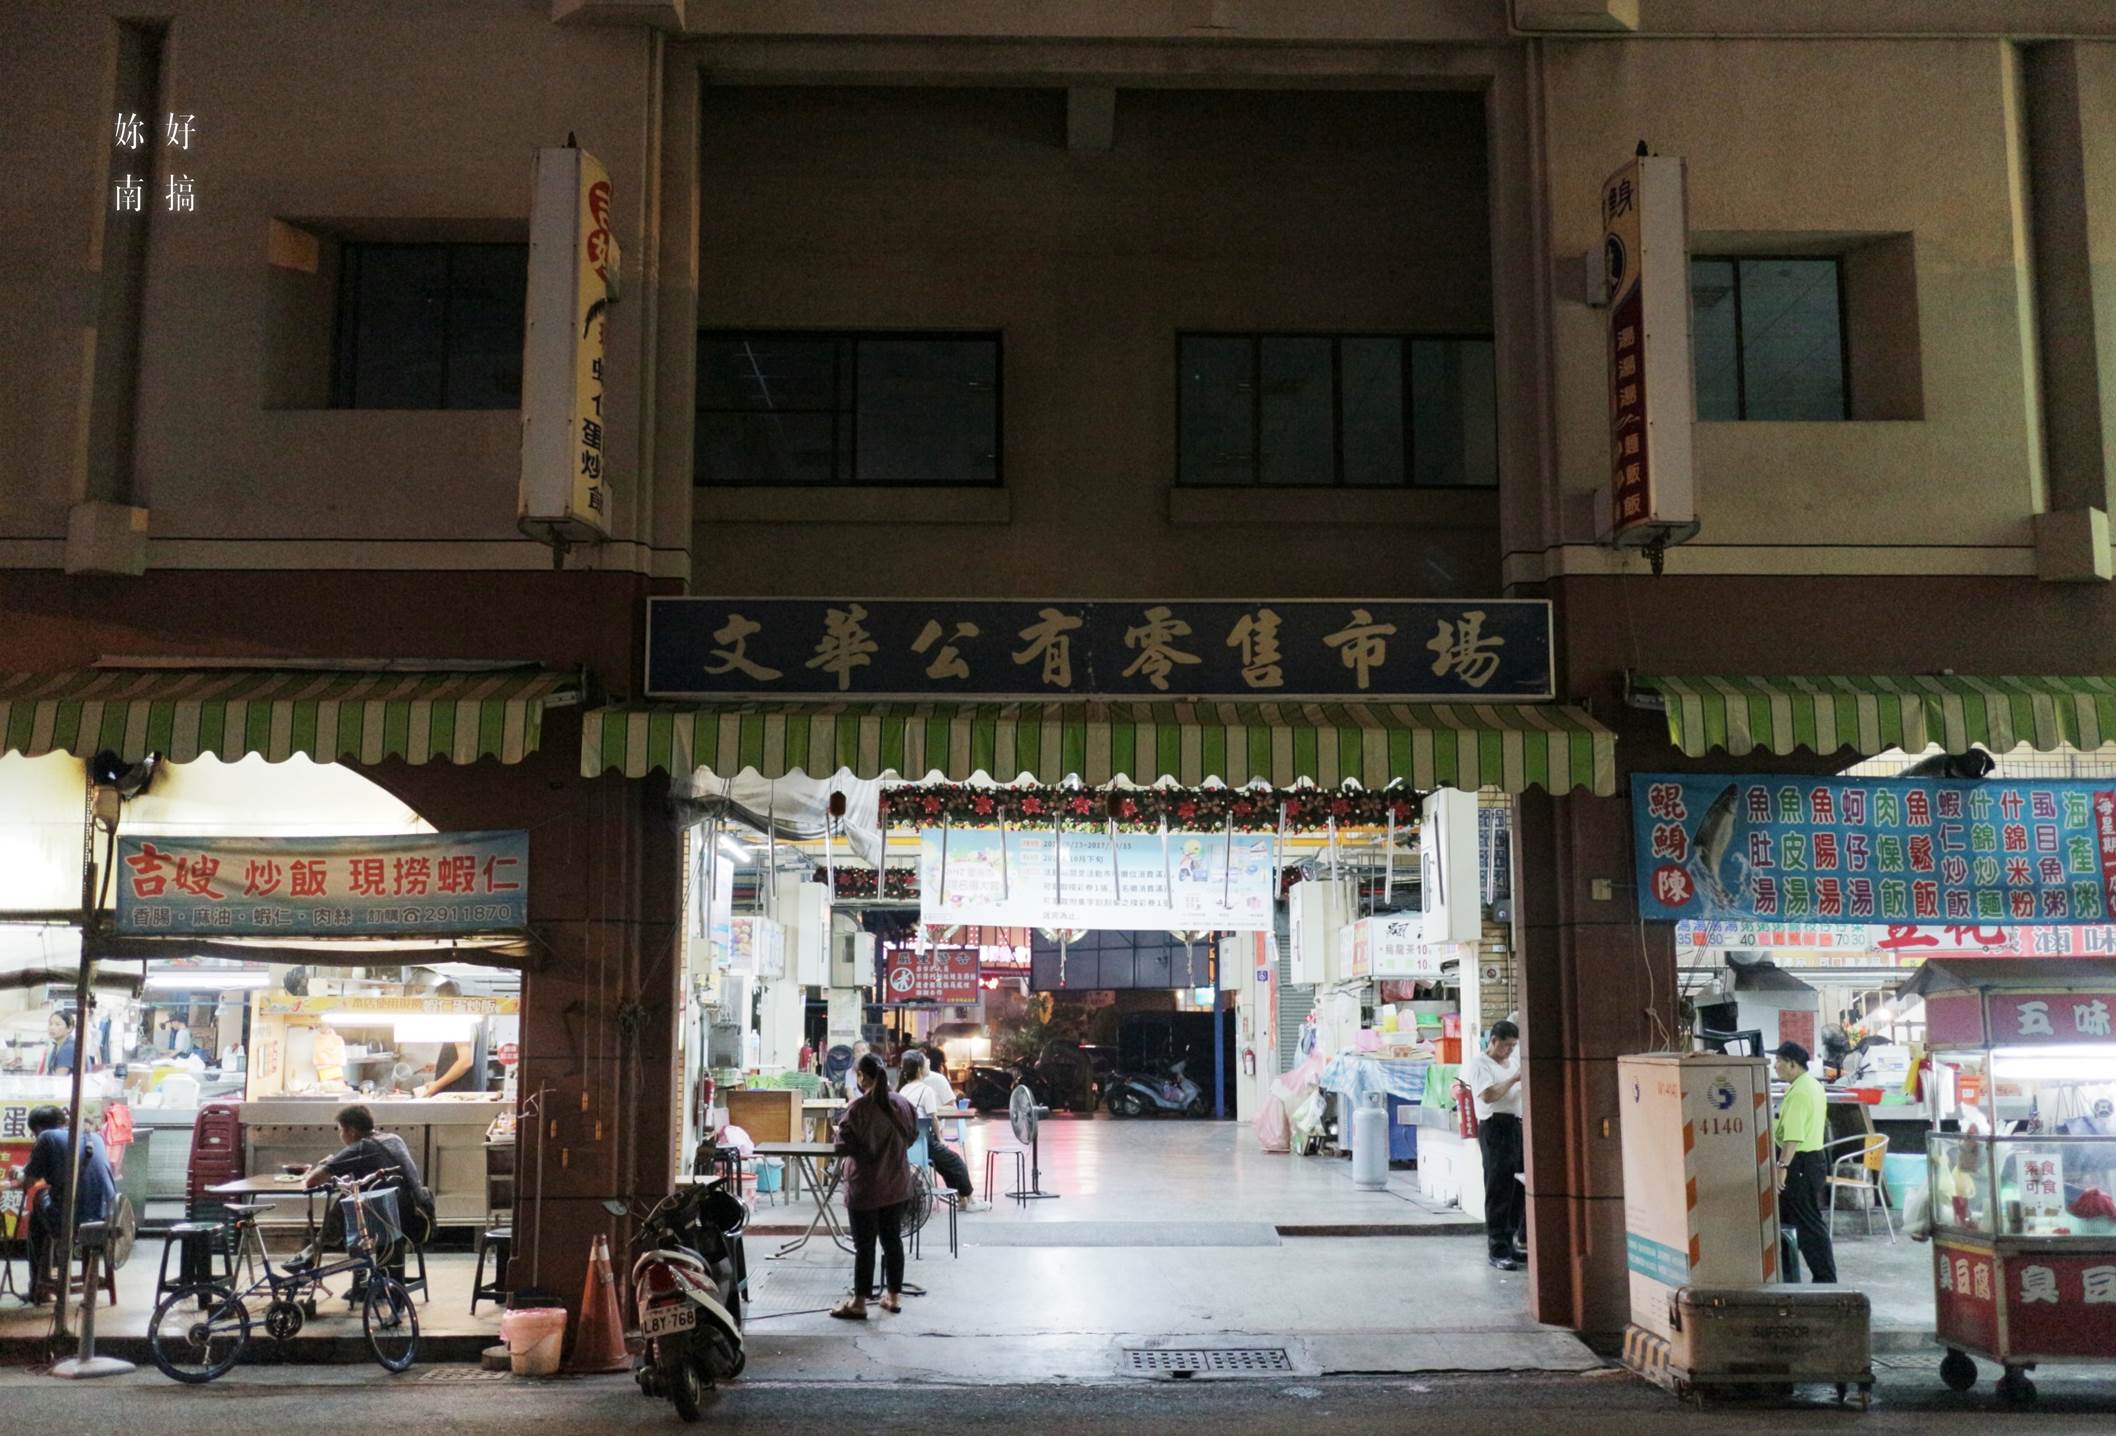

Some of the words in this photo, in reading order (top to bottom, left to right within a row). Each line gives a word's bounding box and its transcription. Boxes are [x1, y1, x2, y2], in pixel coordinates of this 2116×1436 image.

[705, 603, 1505, 690] 文華公有零售市場
[243, 858, 327, 898] 炒飯
[348, 854, 520, 897] 現撈蝦仁
[422, 905, 512, 923] 2911870
[1746, 786, 1778, 914] 魚肚湯
[1777, 786, 1810, 916] 魚皮湯
[1809, 786, 1842, 916] 魚腸湯
[1841, 788, 1874, 916] 蚵仔湯
[1874, 788, 1907, 918] 肉燥飯
[1906, 788, 1940, 919] 魚鬆飯
[1936, 790, 1972, 918] 蝦仁炒飯
[1969, 789, 2004, 918] 什錦炒麵
[2001, 789, 2036, 918] 什錦米粉
[2064, 791, 2101, 919] 海產粥
[1740, 934, 1756, 946] 40
[1699, 1117, 1744, 1135] 4140
